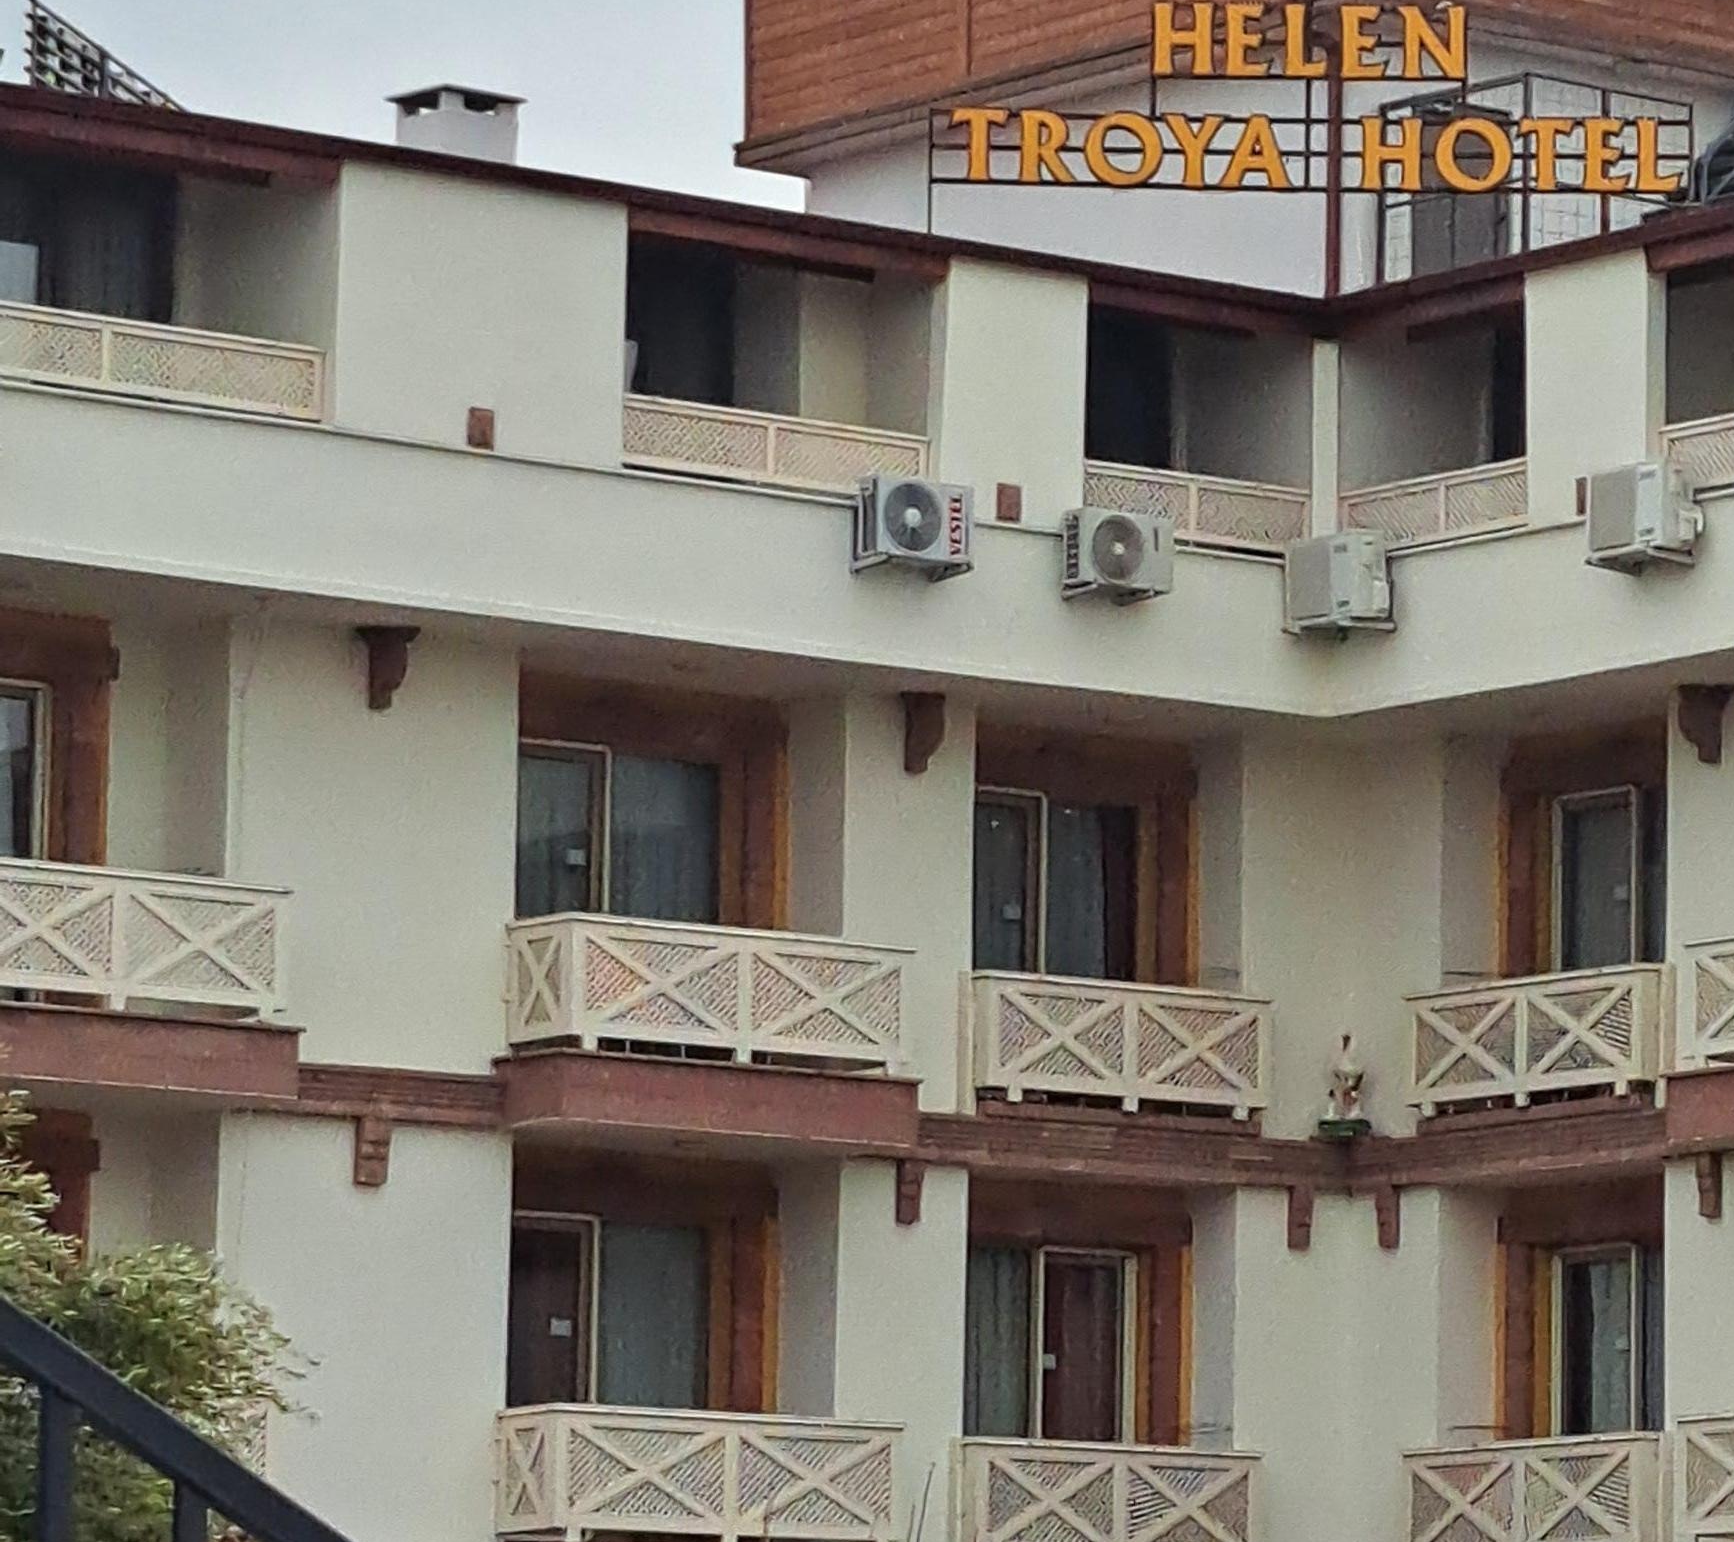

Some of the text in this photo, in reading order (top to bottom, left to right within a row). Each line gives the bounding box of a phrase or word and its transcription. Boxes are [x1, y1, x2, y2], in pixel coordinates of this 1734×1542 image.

[1151, 2, 1467, 78] HELEN
[951, 107, 1682, 195] TROYA HOTEL
